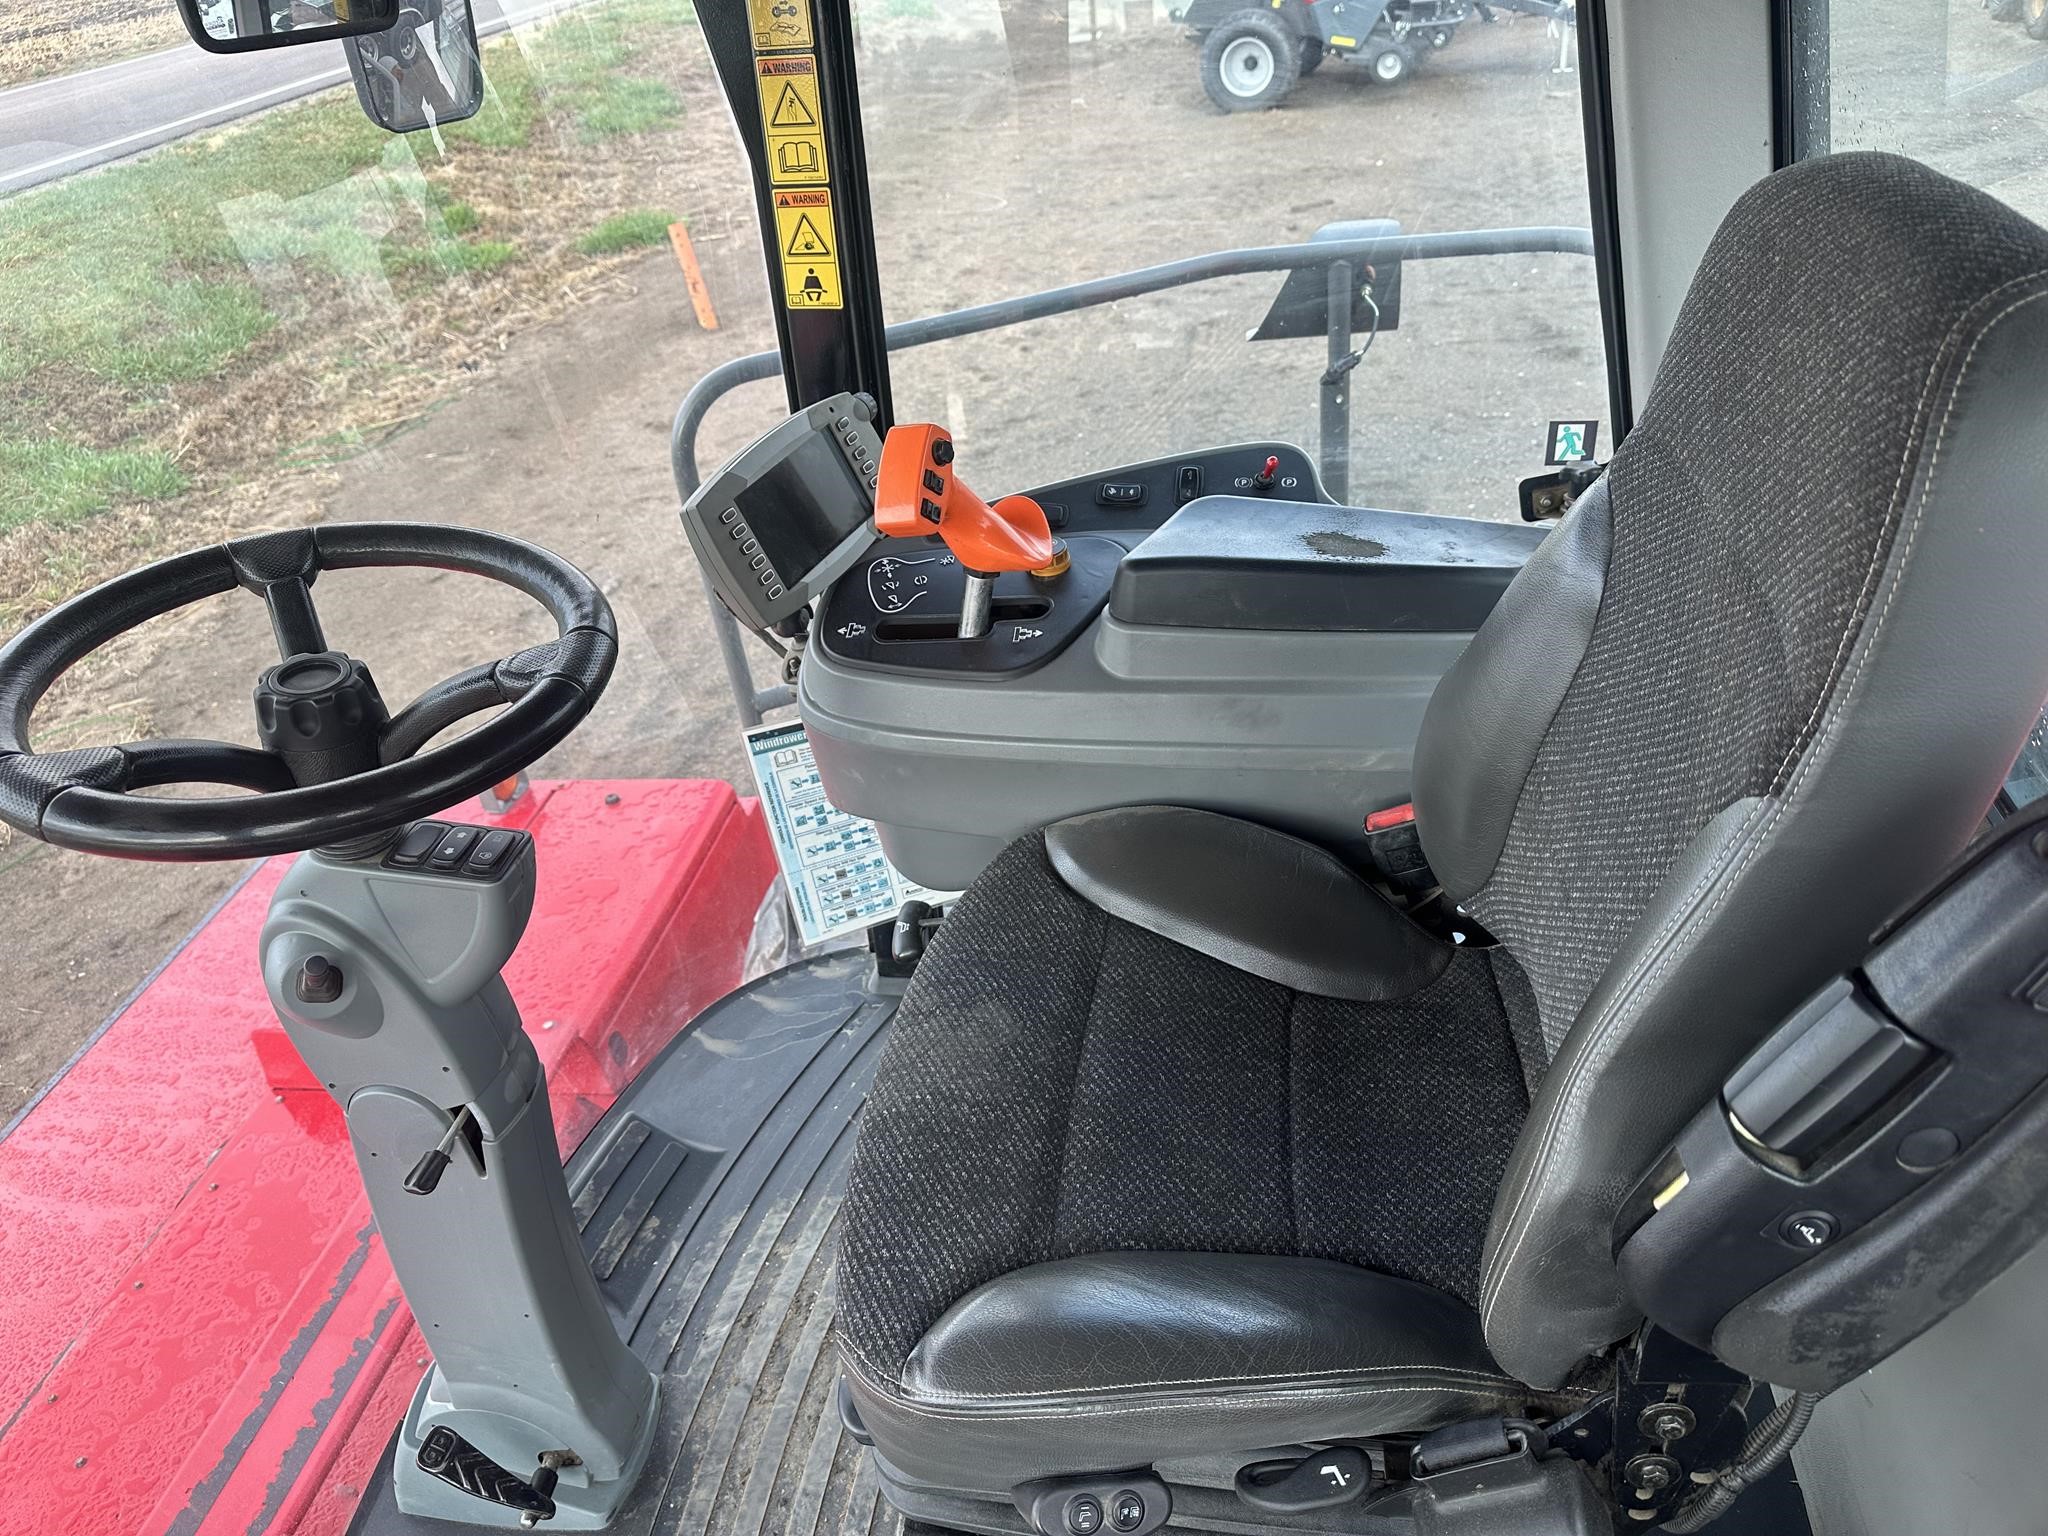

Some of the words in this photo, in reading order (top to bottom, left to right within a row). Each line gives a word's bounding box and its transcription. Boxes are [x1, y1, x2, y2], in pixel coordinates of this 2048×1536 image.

[772, 61, 812, 74] WARNING
[791, 193, 826, 205] WARNING
[753, 732, 808, 751] Windrower
